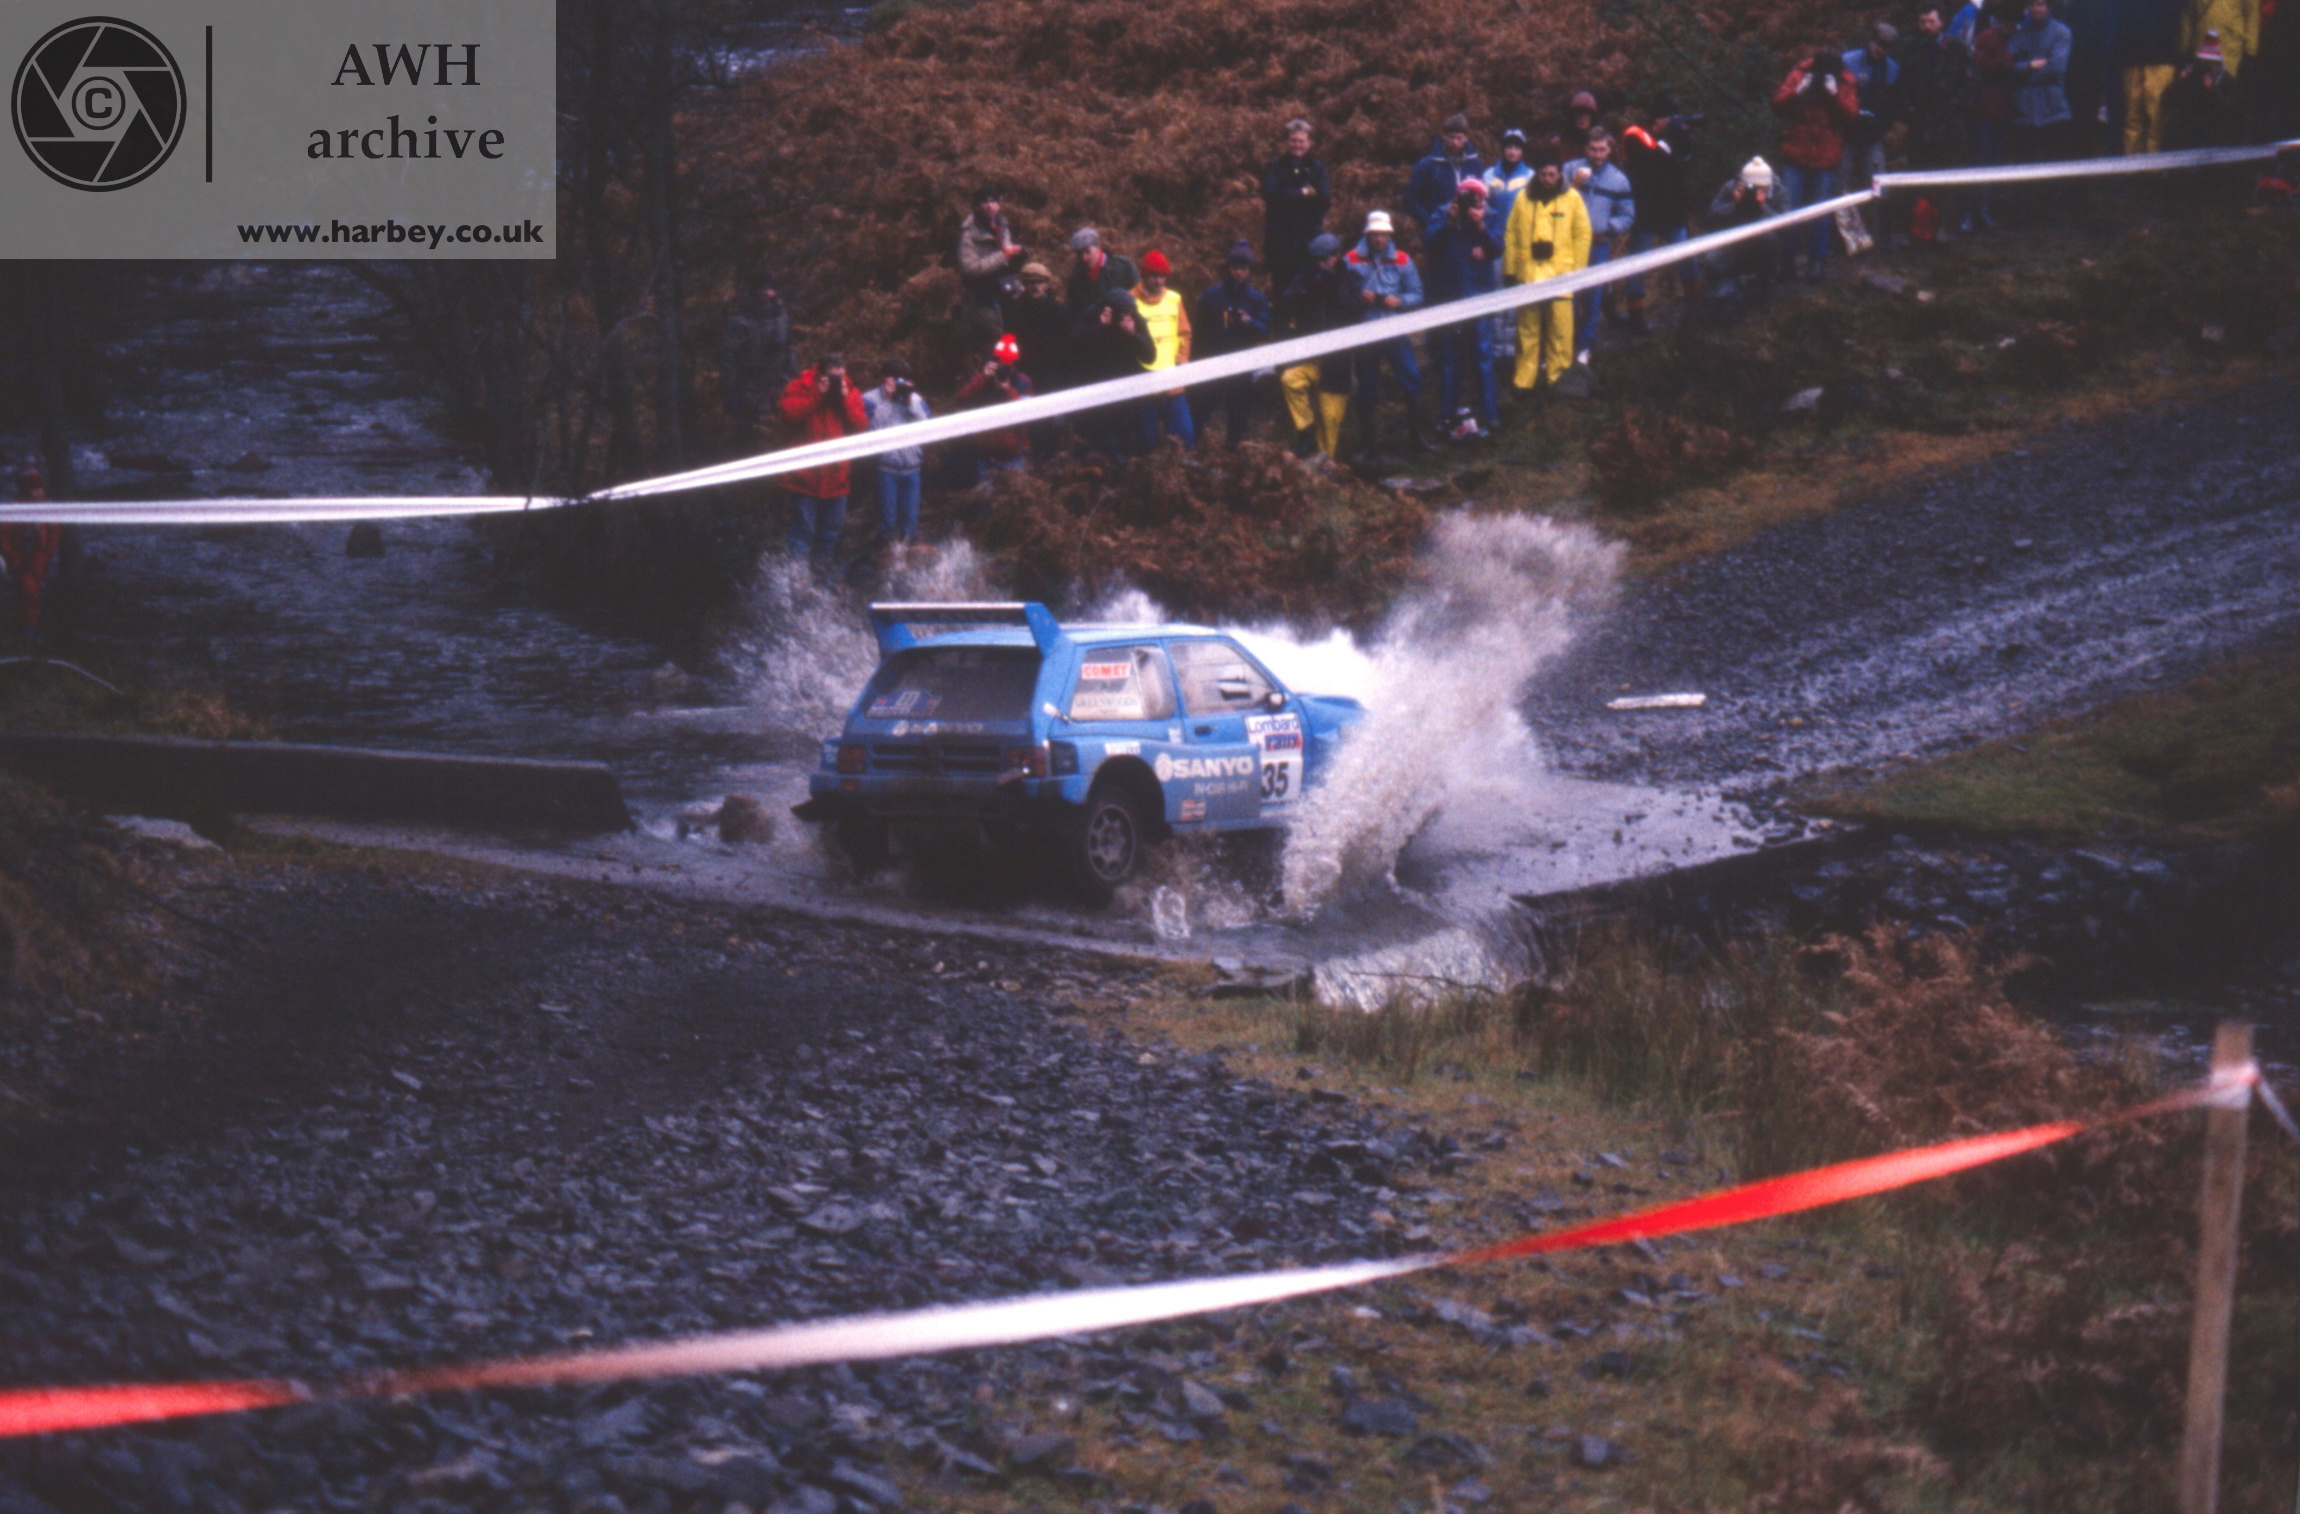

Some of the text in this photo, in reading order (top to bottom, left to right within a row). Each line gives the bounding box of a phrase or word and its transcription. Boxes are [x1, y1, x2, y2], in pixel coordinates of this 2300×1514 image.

[1083, 664, 1128, 677] COMET
[1247, 714, 1300, 733] Lombard
[1173, 757, 1254, 778] SANYO
[1260, 761, 1288, 798] 35
